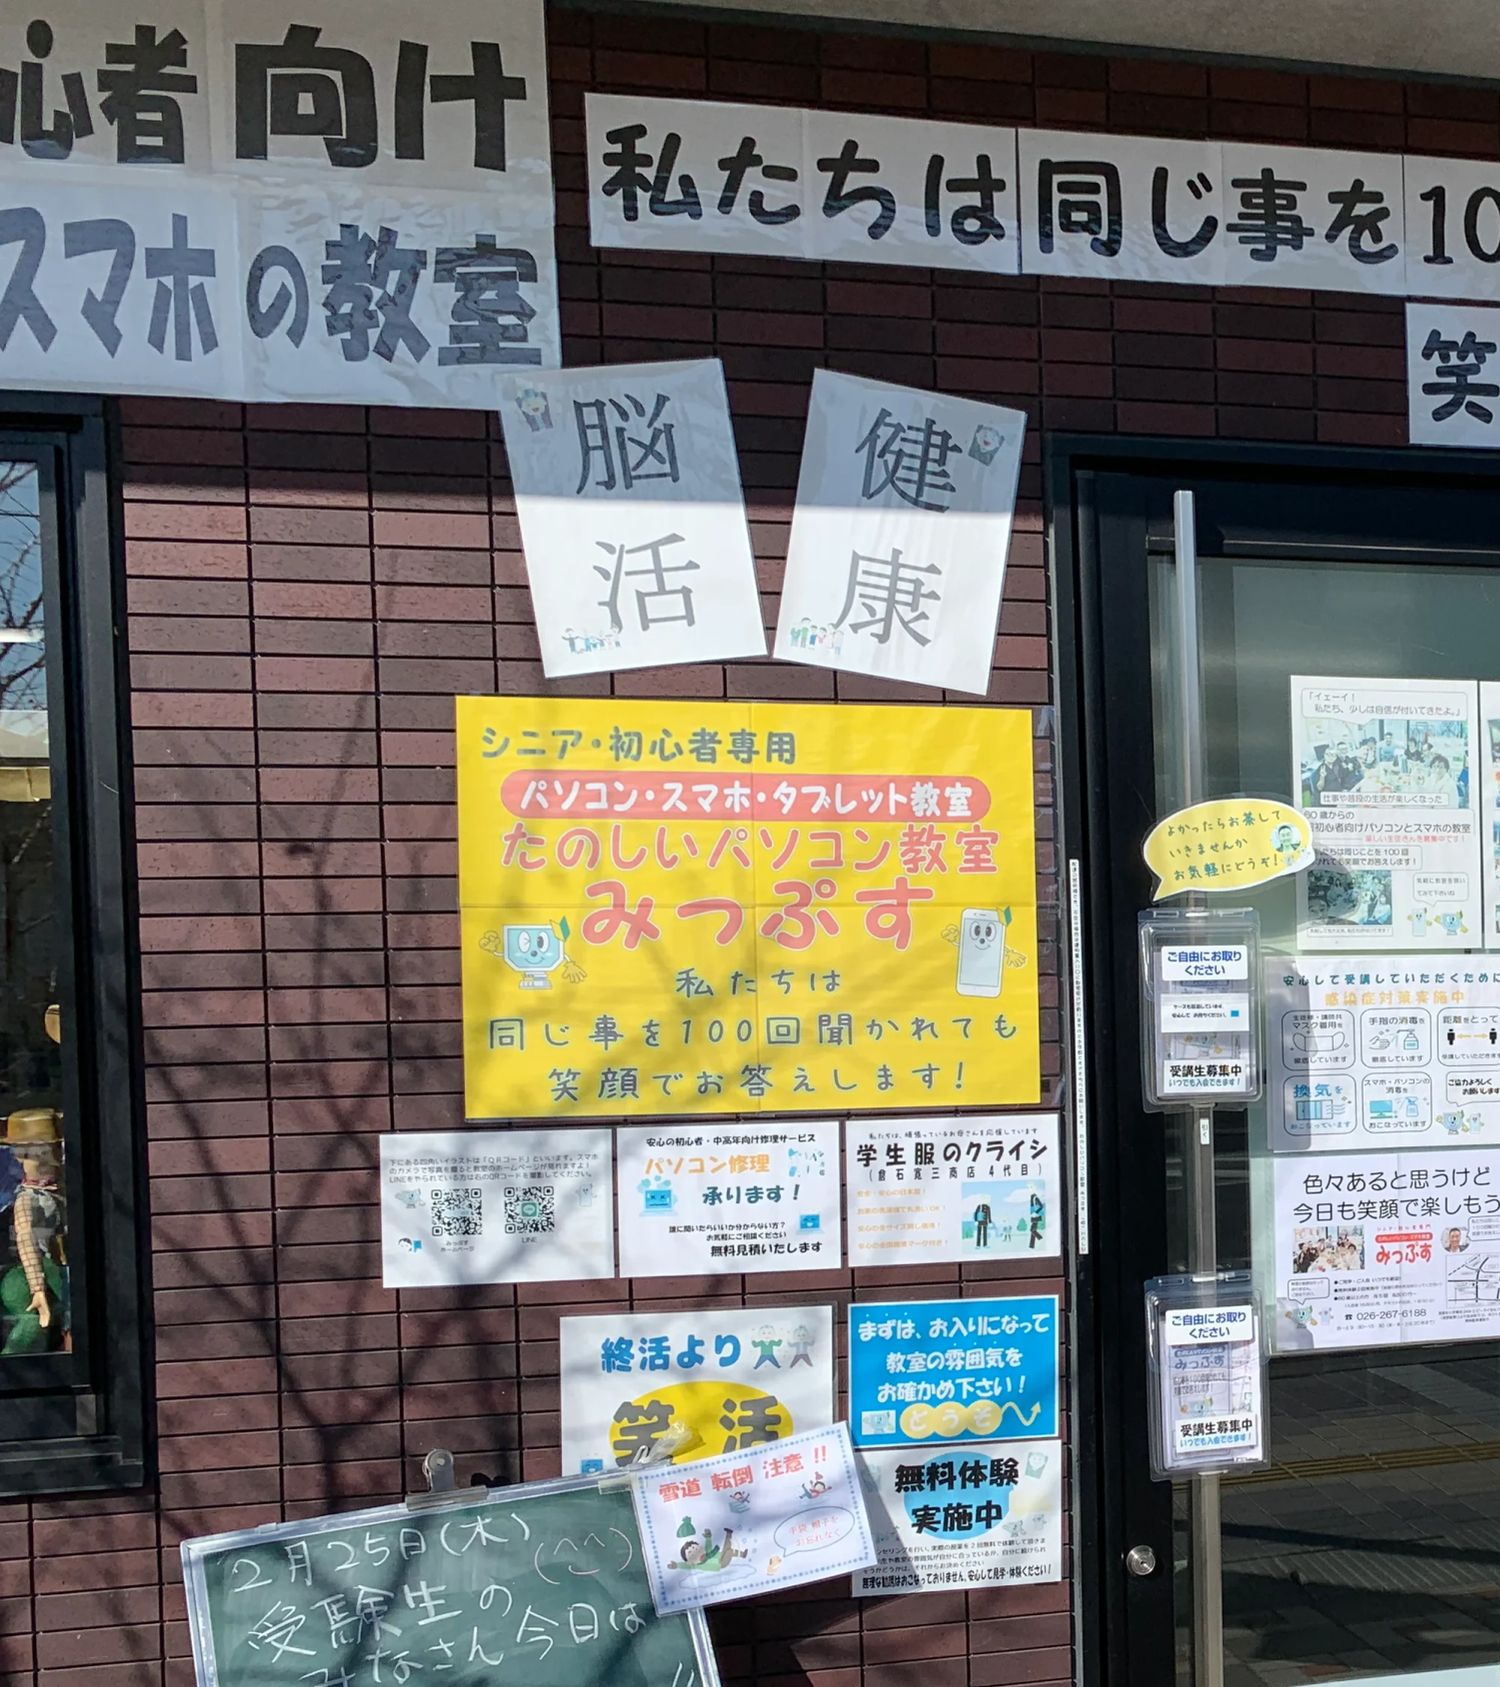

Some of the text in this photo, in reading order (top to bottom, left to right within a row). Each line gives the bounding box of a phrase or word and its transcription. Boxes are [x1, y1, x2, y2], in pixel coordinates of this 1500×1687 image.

[0, 207, 542, 366] スマホの教室
[1167, 810, 1281, 837] よかったらお茶して
[501, 822, 999, 875] たのしいパソコン教室
[1169, 838, 1248, 858] いきませんか
[581, 876, 935, 951] みっぷす
[1168, 950, 1242, 963] ご自由にお取り
[676, 968, 841, 997] 私たちは
[1185, 965, 1225, 976] ください
[489, 1014, 1018, 1051] 同じ事を100回聞かれても
[549, 1061, 965, 1102] 笑顔でお答えします！
[1170, 1064, 1242, 1078] 受講生募集中
[1293, 1084, 1343, 1099] 換気を
[645, 1154, 770, 1175] パソコン修理
[857, 1138, 1048, 1167] 学生服のクライシ
[1303, 1166, 1491, 1195] 色々あると思うけど
[702, 1184, 801, 1206] 承ります！
[711, 1241, 823, 1257] 無料見積いたします
[1376, 1242, 1432, 1266] みっぷす
[858, 1313, 1050, 1342] まずは、お入りになって
[1172, 1311, 1246, 1326] ご自由にお取り
[1356, 1308, 1427, 1321] 026-267-6188
[1189, 1327, 1230, 1338] ください
[601, 1334, 741, 1373] 終活より
[886, 1347, 1023, 1374] 教室の雰囲気を
[877, 1375, 1026, 1403] お確かめ下さい！
[909, 1407, 992, 1432] どうぞ
[1180, 1418, 1253, 1438] 受講生募集中
[659, 1478, 702, 1503] 雪道
[711, 1465, 754, 1492] 転倒
[763, 1453, 804, 1479] 注意
[894, 1457, 1020, 1494] 無料体験
[911, 1500, 1003, 1534] 実施中
